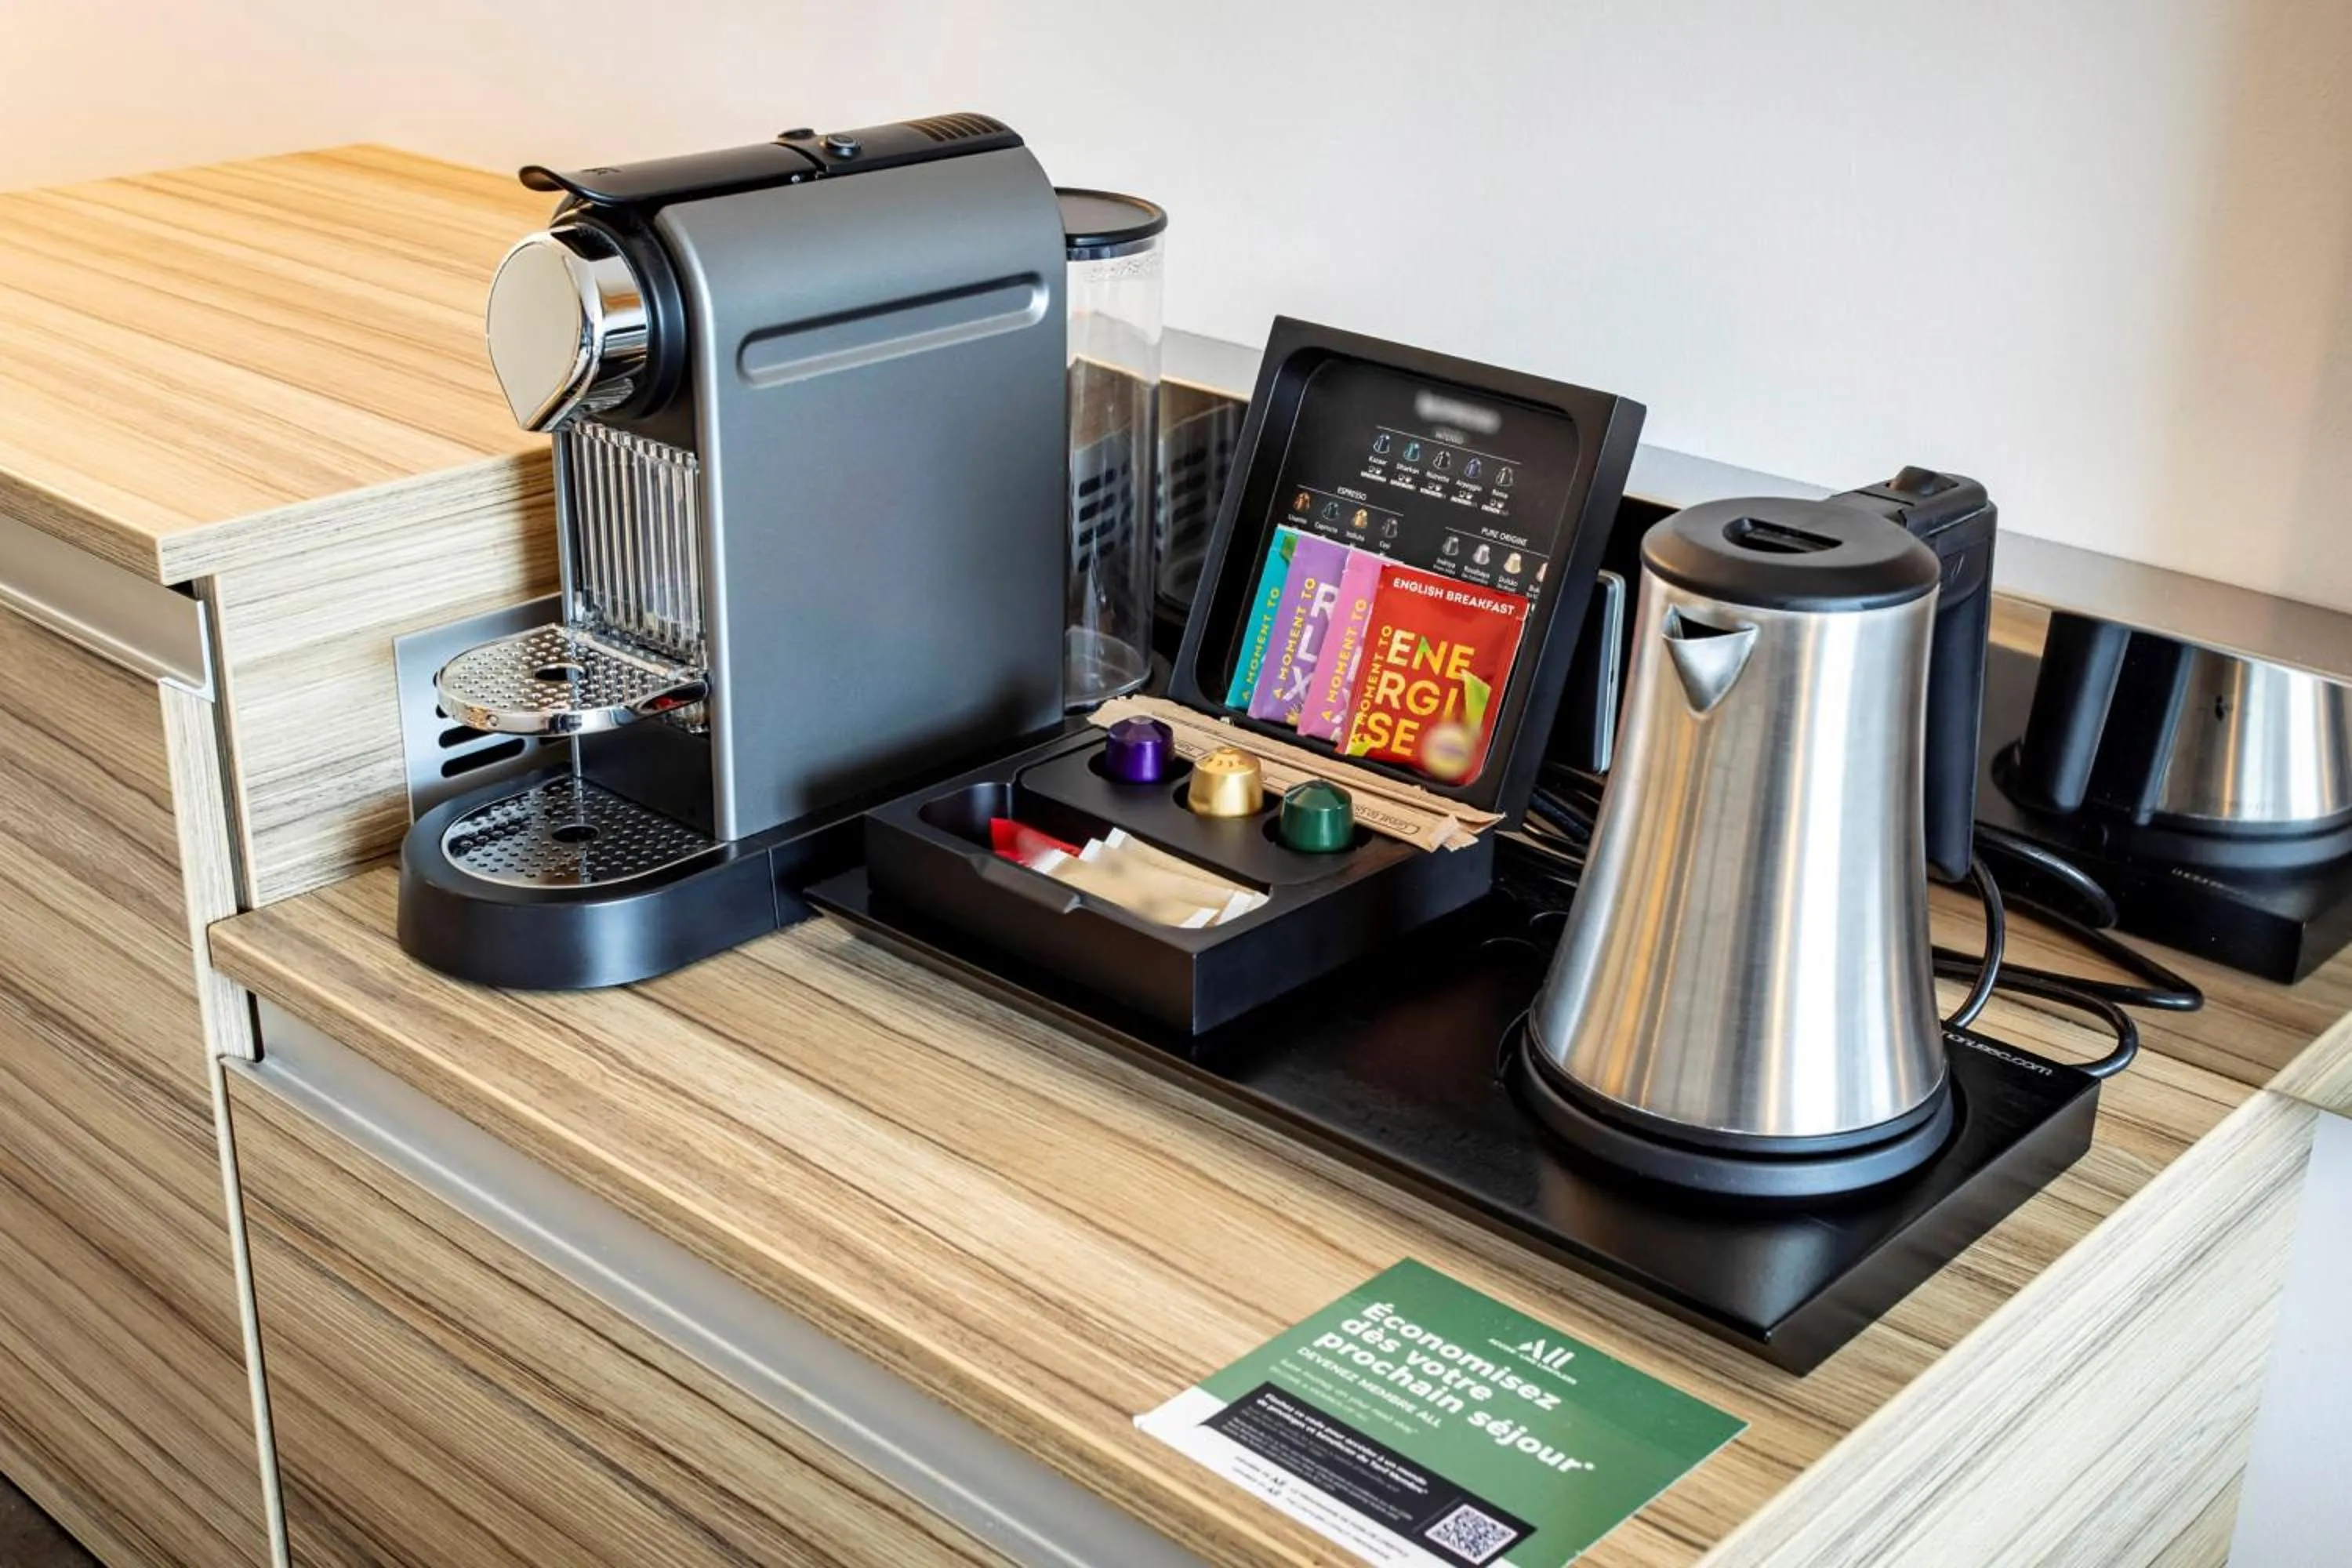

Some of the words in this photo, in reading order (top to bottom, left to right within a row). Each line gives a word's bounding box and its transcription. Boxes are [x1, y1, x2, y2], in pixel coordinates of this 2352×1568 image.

[1480, 526, 1500, 540] PURE
[1247, 614, 1272, 684] MOMENT
[1267, 587, 1280, 608] TO
[1377, 625, 1392, 647] TO
[1393, 576, 1444, 599] ENGLISH
[1446, 591, 1515, 616] BREAKFAST
[1272, 687, 1284, 699] A
[1279, 606, 1307, 681] MOMENT
[1301, 577, 1316, 600] TO
[1320, 710, 1332, 721] A
[1327, 626, 1359, 702] MOMENT
[1351, 598, 1367, 621] TO
[1386, 628, 1475, 681] ENE
[1367, 711, 1420, 757] SE
[1297, 1347, 1359, 1382] DEVENEZ
[1357, 1378, 1417, 1414] MEMBRE
[1416, 1410, 1442, 1428] ALL
[1312, 1332, 1464, 1414] prochain
[1341, 1319, 1401, 1352] dès
[1406, 1349, 1493, 1401] votre
[1361, 1302, 1562, 1410] Économisez
